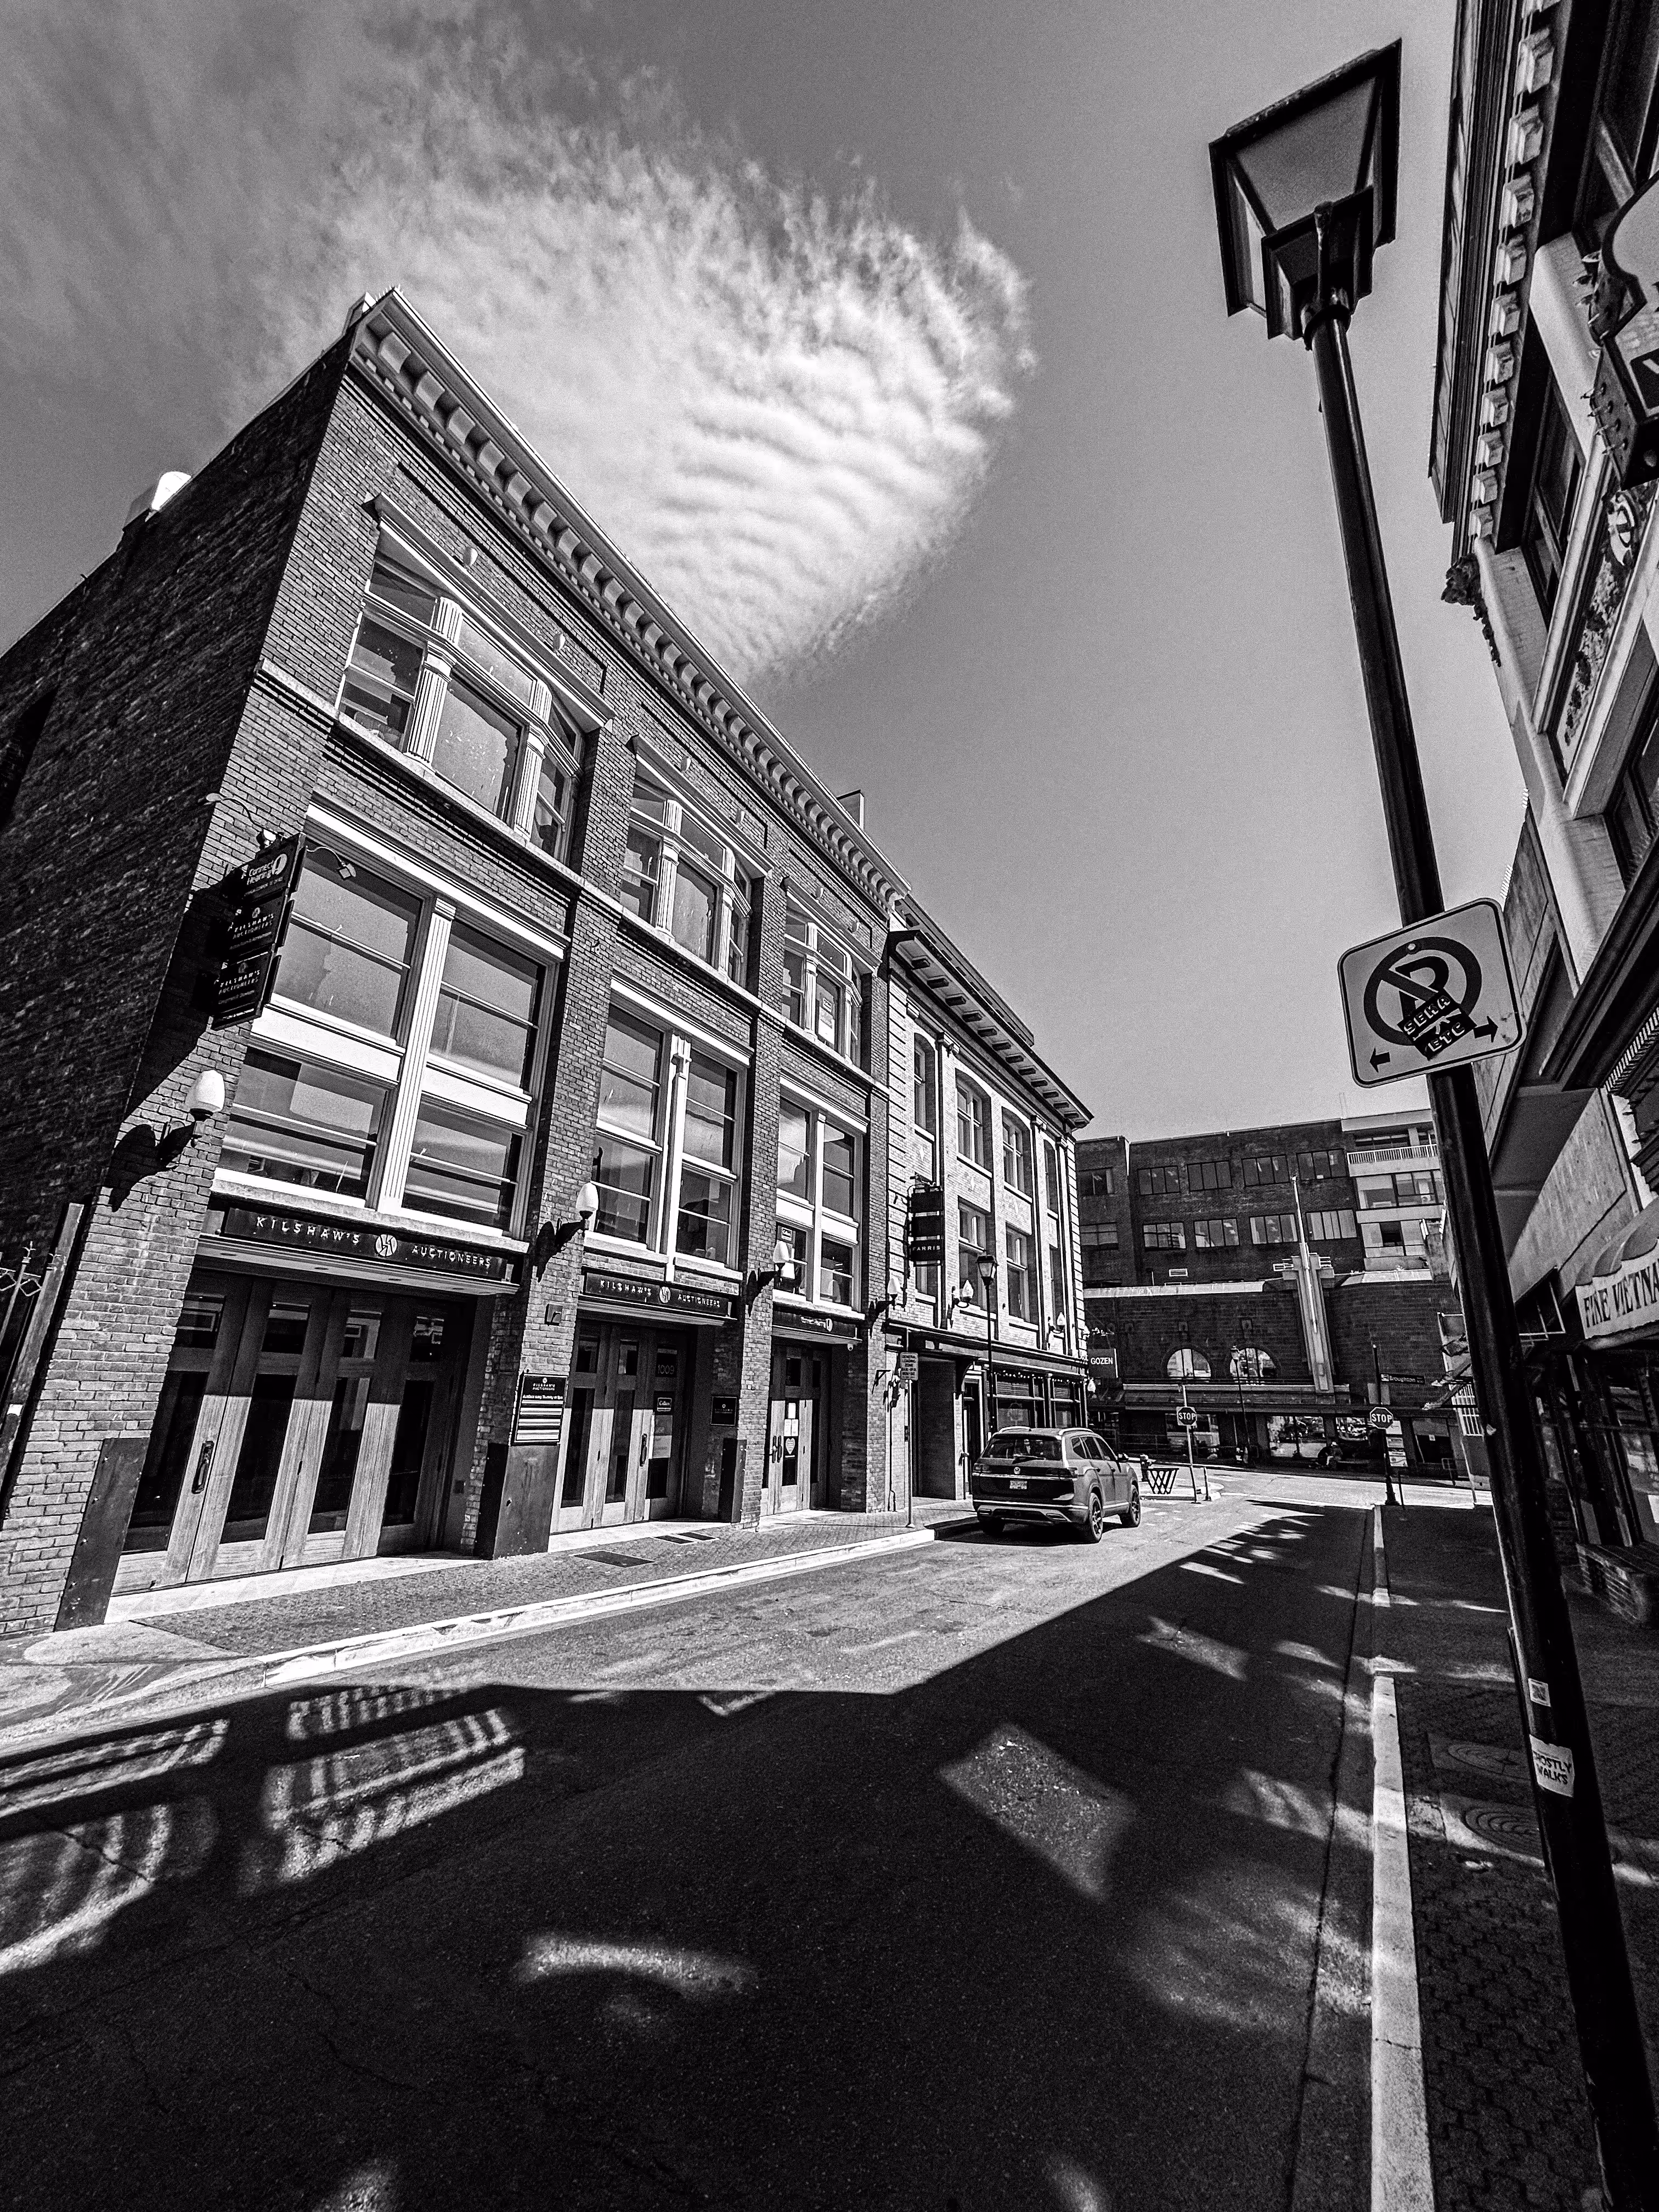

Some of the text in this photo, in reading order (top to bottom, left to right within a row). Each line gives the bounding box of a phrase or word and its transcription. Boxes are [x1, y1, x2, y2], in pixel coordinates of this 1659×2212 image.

[1427, 1022, 1465, 1052] ETC
[256, 1216, 492, 1268] KILSHAW'S AUCTIONEERS
[600, 1279, 720, 1308] KILSHAW'S AUCTIONEERS
[1583, 1258, 1659, 1328] FINE VIETNA
[658, 1364, 675, 1375] 1009
[1090, 1357, 1114, 1365] GOZEN
[1178, 1412, 1197, 1421] STOP
[1371, 1413, 1393, 1423] STOP
